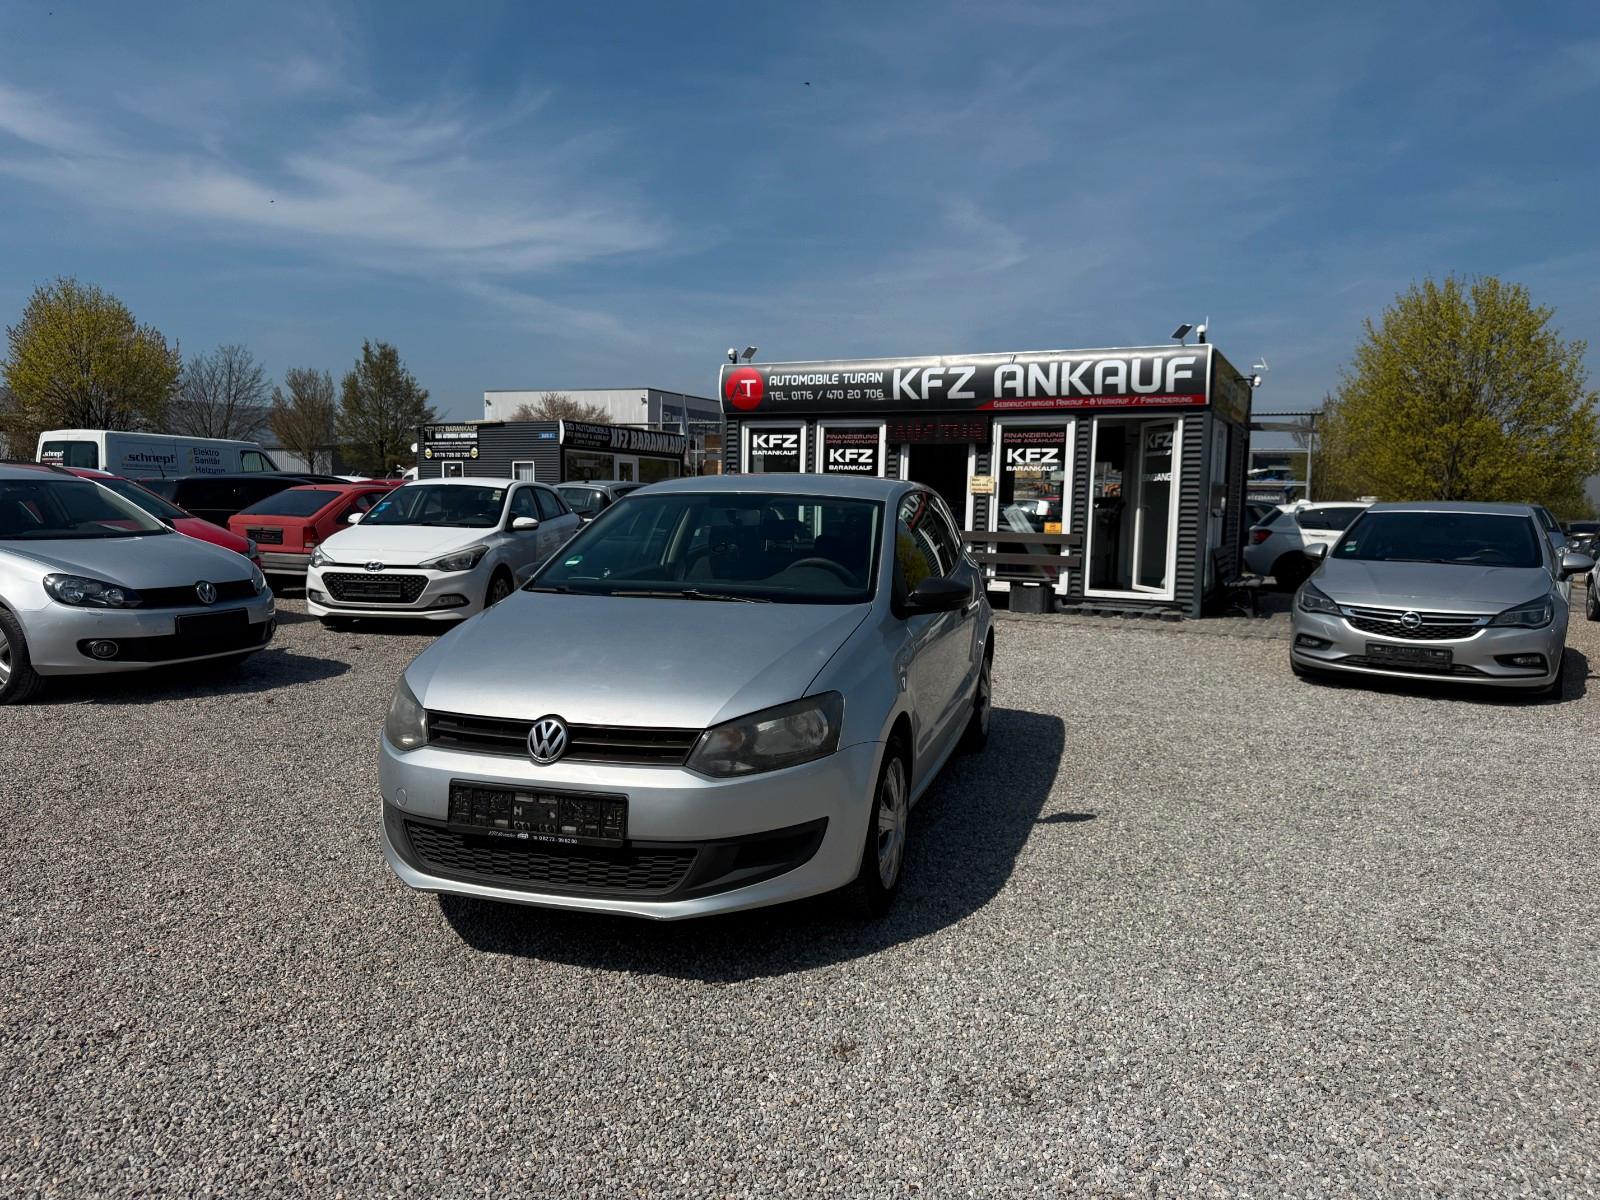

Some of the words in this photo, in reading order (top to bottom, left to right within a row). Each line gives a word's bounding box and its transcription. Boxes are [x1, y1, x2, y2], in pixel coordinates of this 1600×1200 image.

[769, 374, 839, 386] AUTOMOBILE
[843, 372, 884, 384] TURAN
[892, 366, 976, 400] KFZ
[993, 356, 1197, 398] ANKAUF
[769, 391, 789, 401] TEL.
[791, 390, 814, 400] 0176
[826, 390, 844, 399] 470
[847, 389, 861, 399] 20
[864, 388, 884, 399] 706
[610, 427, 629, 449] KFZ
[629, 430, 686, 454] BARANKAUF
[752, 434, 798, 448] KFZ
[128, 452, 176, 465] schnepf
[193, 448, 220, 457] Elektro
[829, 449, 873, 463] KFZ
[1006, 448, 1059, 463] KFZ
